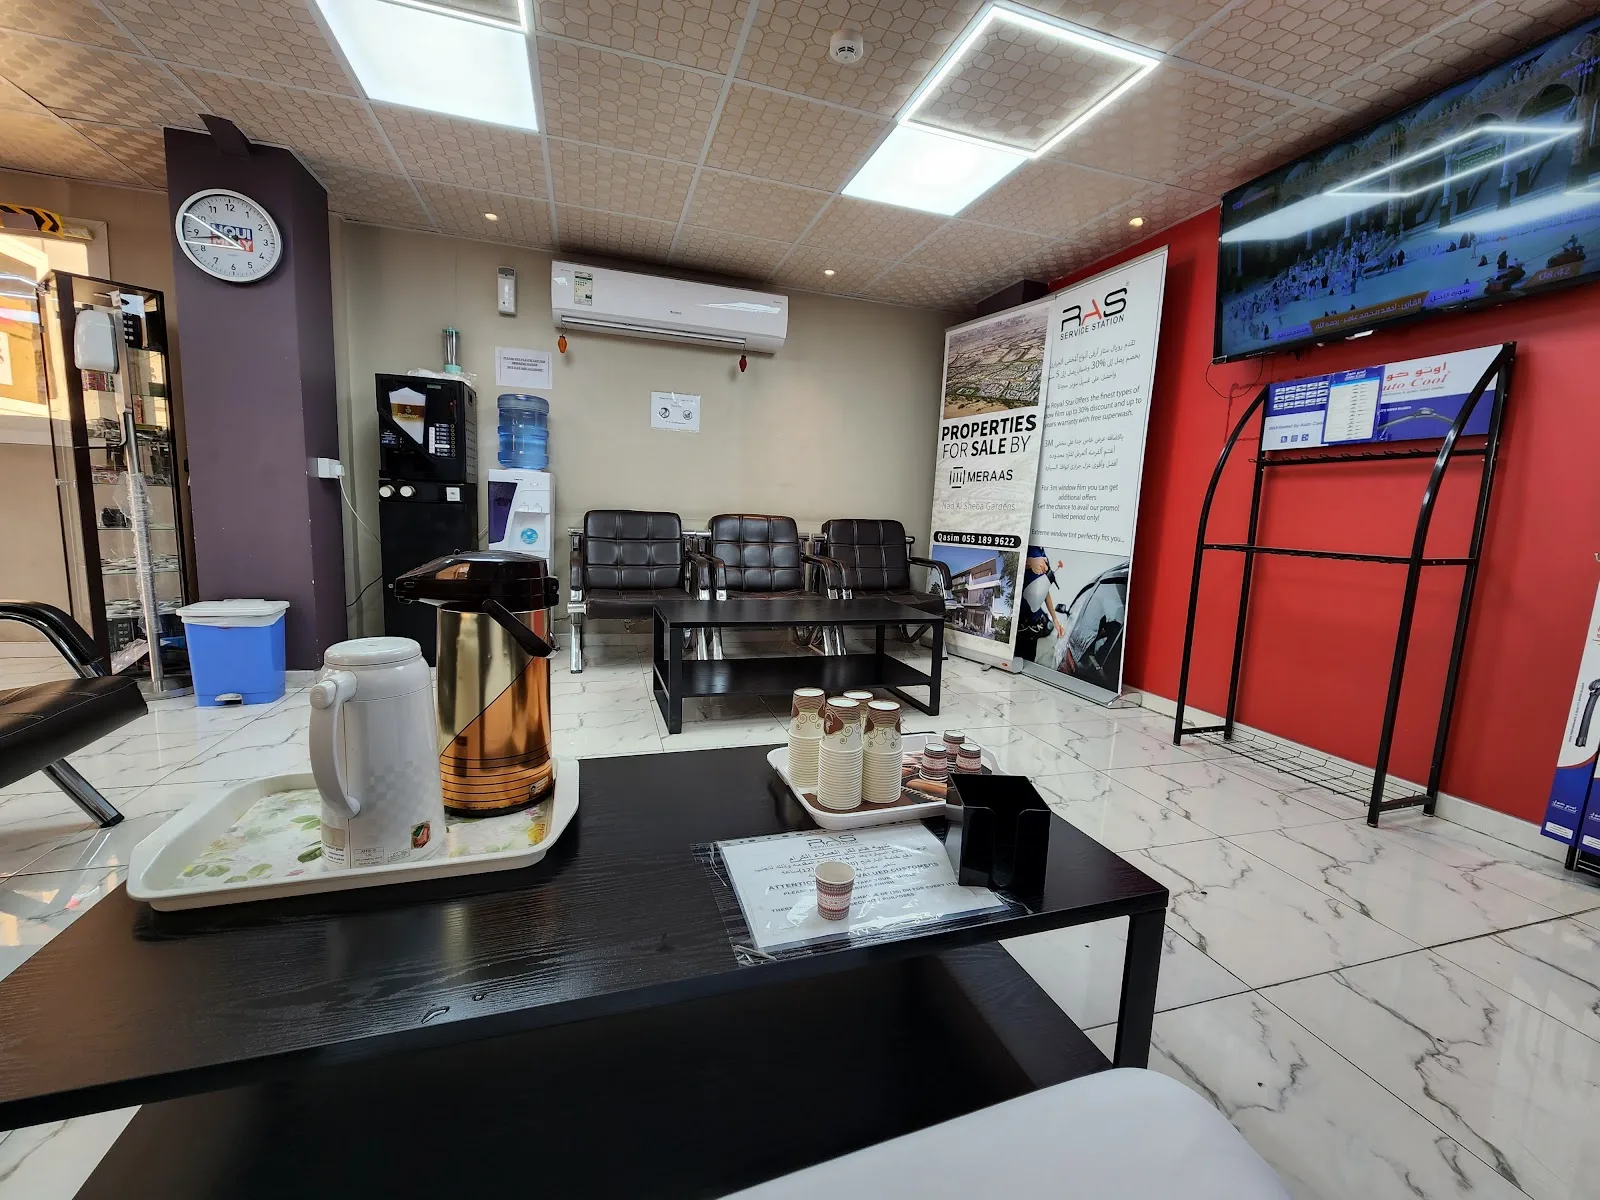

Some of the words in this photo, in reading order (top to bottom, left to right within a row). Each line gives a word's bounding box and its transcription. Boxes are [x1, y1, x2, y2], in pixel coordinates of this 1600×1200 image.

[209, 205, 217, 214] 11
[225, 203, 236, 213] 12
[246, 211, 250, 219] 1
[194, 229, 200, 237] 9
[264, 239, 269, 247] 3
[213, 257, 219, 265] 7
[248, 262, 254, 270] 5
[1061, 287, 1128, 332] RAS
[1060, 324, 1090, 341] SERVICE
[1091, 313, 1125, 331] STATION
[1091, 359, 1106, 370] 30%
[1383, 382, 1405, 392] uto
[1411, 373, 1448, 388] Cool
[1386, 370, 1410, 382] كو
[1051, 399, 1065, 411] Royal
[1065, 398, 1075, 408] Star
[1075, 396, 1089, 405] Offers
[1100, 391, 1116, 401] finest
[1116, 388, 1132, 399] types
[1132, 384, 1141, 394] of
[1055, 408, 1066, 418] film
[1090, 400, 1114, 411] discount
[1114, 399, 1126, 408] and
[1126, 398, 1135, 408] up
[1135, 396, 1143, 404] to
[1057, 415, 1079, 427] warranty
[1079, 414, 1090, 423] with
[1090, 412, 1102, 421] free
[1102, 408, 1134, 421] superwash.
[941, 414, 1037, 442] PROPERTIES
[942, 442, 968, 459] FOR
[970, 437, 1007, 457] SALE
[1010, 434, 1031, 453] BY
[967, 468, 1013, 482] MERAAS
[1076, 483, 1087, 491] film
[1109, 484, 1119, 493] get
[986, 501, 1016, 511] Gardens
[1070, 513, 1086, 521] period
[1086, 515, 1101, 523] only!
[937, 533, 960, 544] Qasim
[961, 534, 976, 544] 055
[977, 535, 992, 545] 189
[994, 536, 1015, 547] 9622
[1031, 528, 1050, 536] Extreme
[1050, 530, 1069, 538] window
[1069, 531, 1077, 539] tint
[1078, 532, 1101, 543] perfectly
[1101, 533, 1110, 542] fits
[856, 869, 889, 878] VALUED
[890, 861, 939, 873] CUSTOMERS
